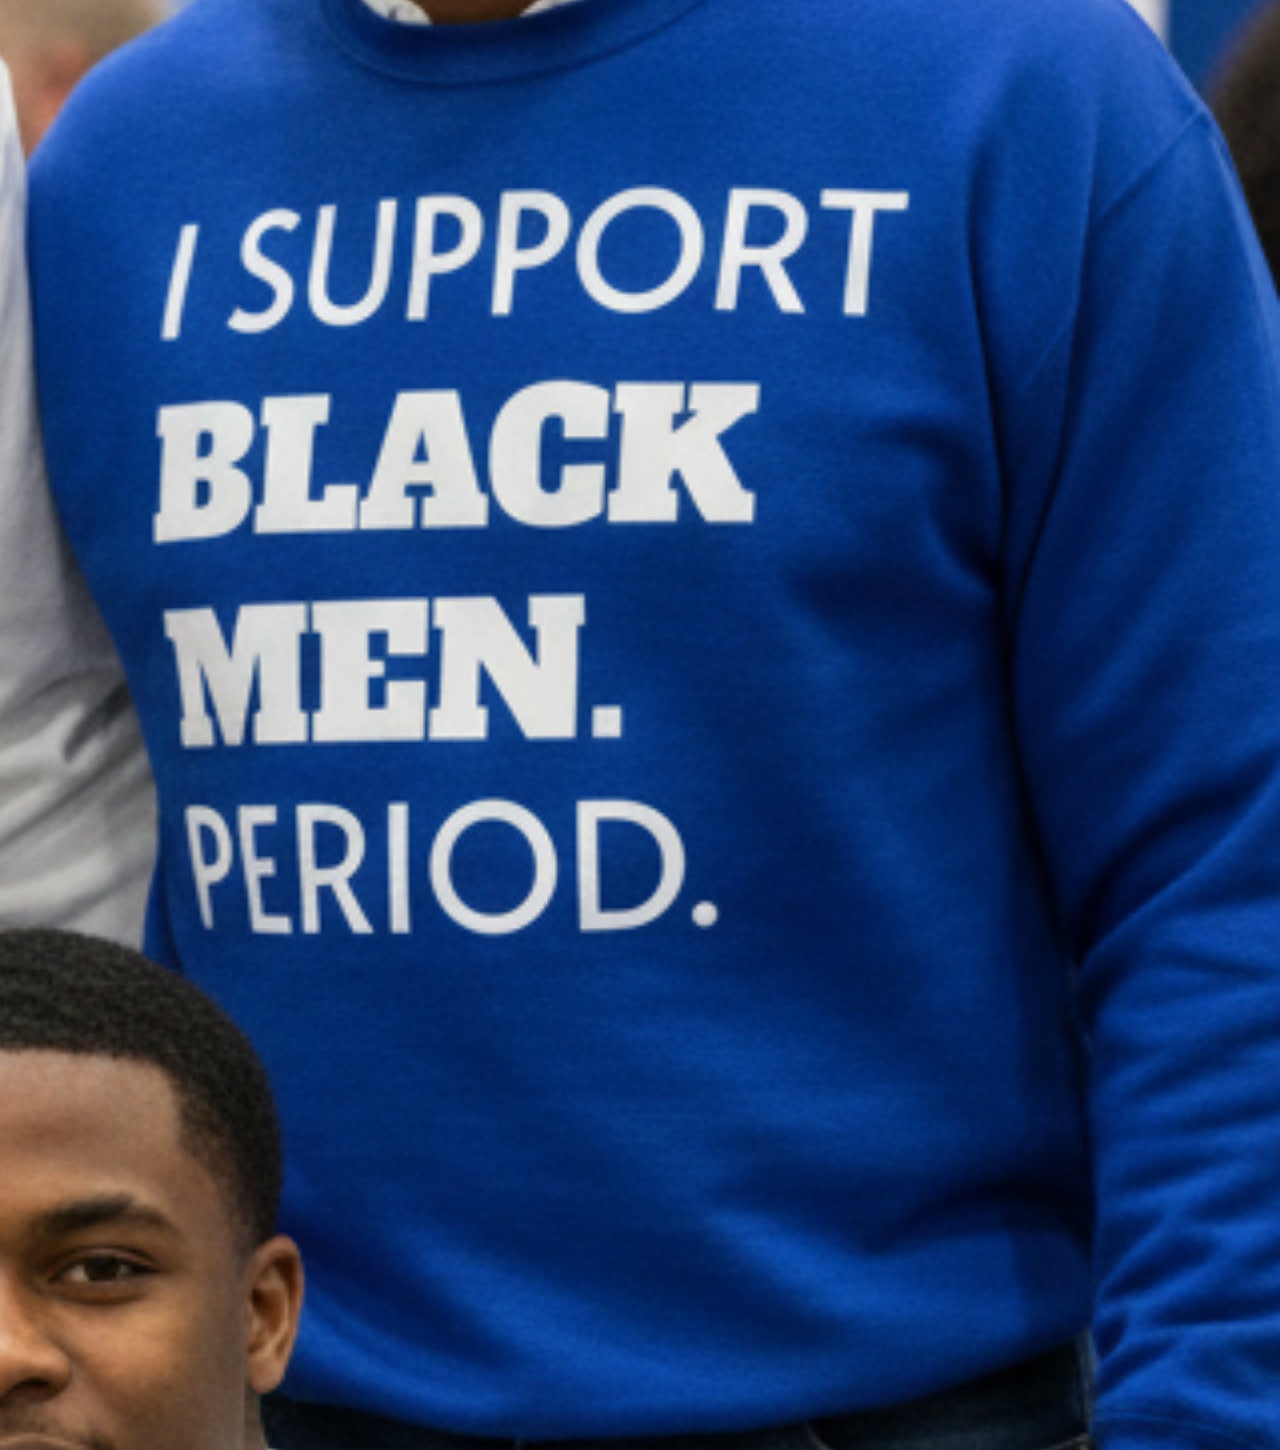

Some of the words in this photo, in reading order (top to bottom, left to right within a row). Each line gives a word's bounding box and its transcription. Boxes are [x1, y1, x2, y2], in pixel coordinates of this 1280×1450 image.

[160, 223, 199, 341] I
[226, 186, 910, 335] SUPPORT
[153, 379, 761, 544] BLACK
[163, 593, 623, 748] MEN.
[184, 797, 719, 936] PERIOD.
